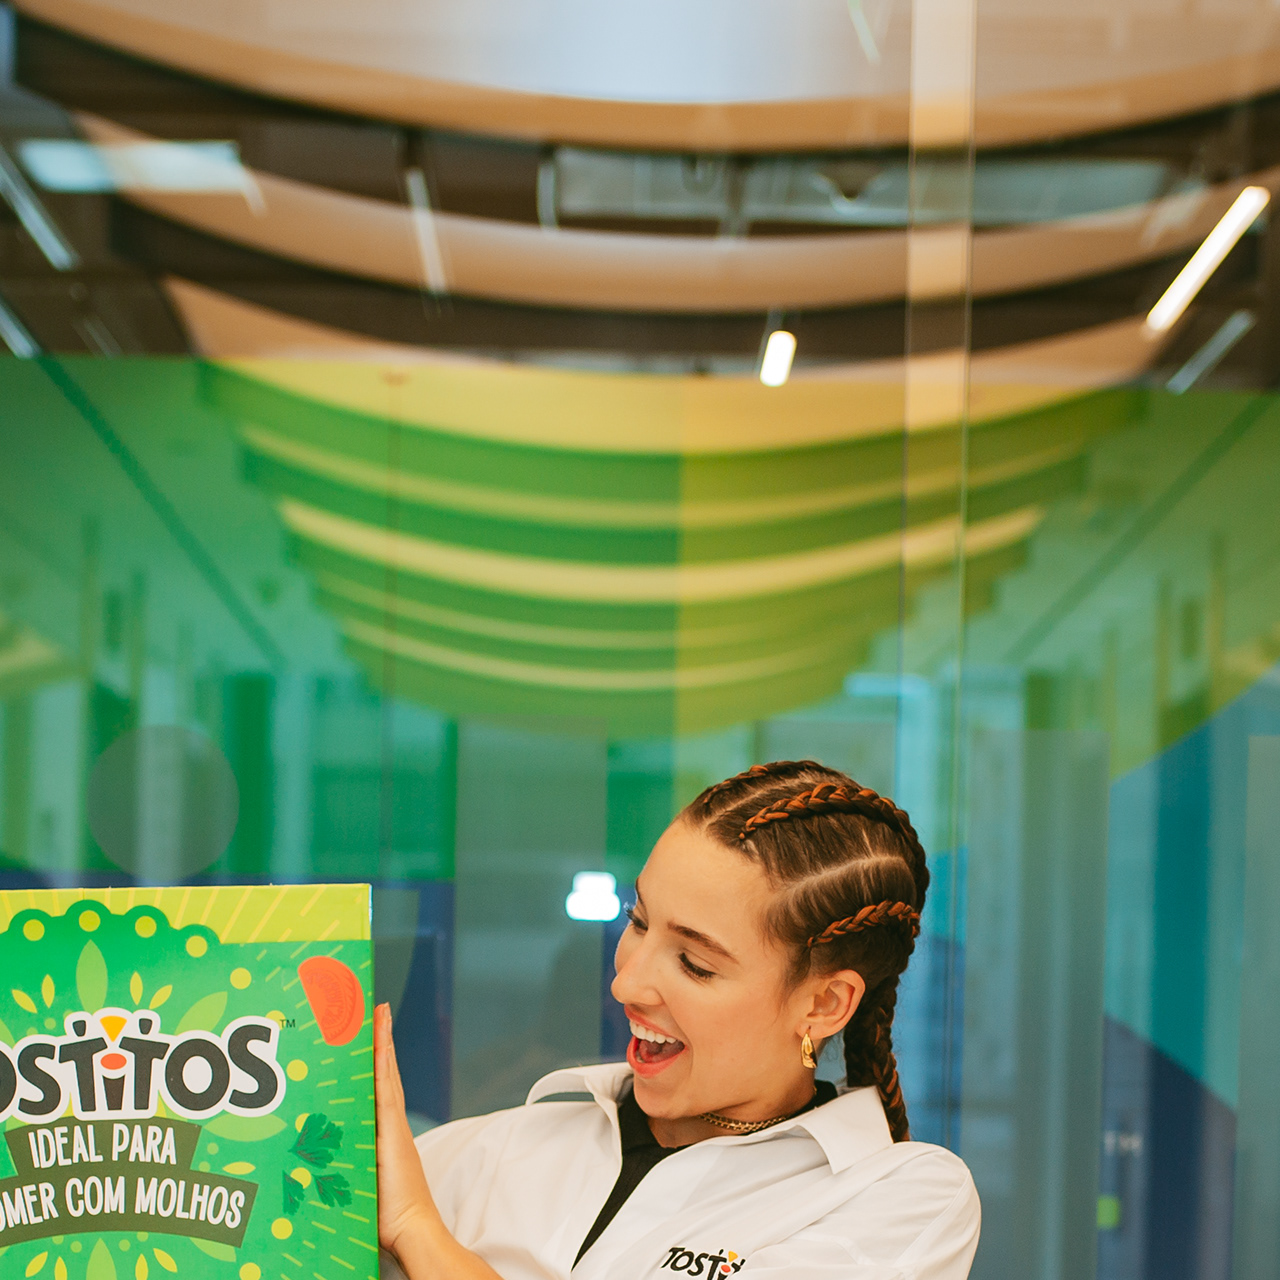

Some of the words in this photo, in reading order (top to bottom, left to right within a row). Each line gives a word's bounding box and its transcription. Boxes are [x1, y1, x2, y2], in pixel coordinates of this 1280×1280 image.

[27, 1124, 104, 1169] IDEAL
[111, 1122, 177, 1166] PARA
[65, 1176, 126, 1218] COM
[134, 1177, 245, 1230] MOLHOS
